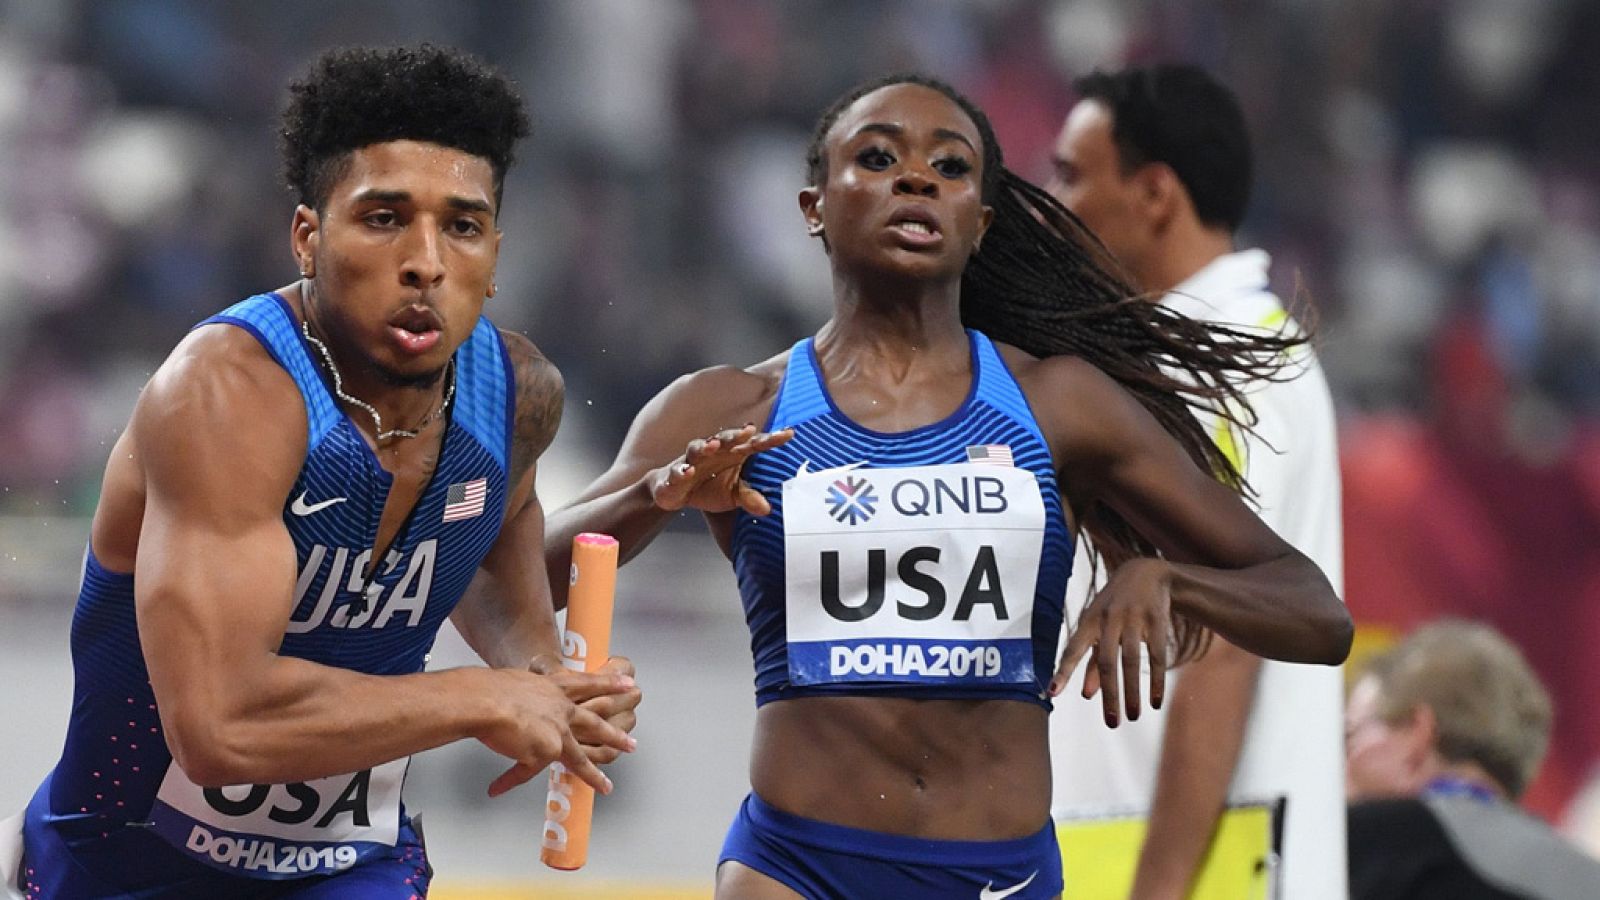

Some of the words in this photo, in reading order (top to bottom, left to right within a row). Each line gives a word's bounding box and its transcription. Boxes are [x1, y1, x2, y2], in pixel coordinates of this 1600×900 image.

[891, 476, 1009, 516] QNB
[286, 539, 438, 634] USA
[820, 545, 1009, 622] USA
[830, 644, 1002, 677] DOHA2019
[185, 825, 357, 873] DOHA2019
